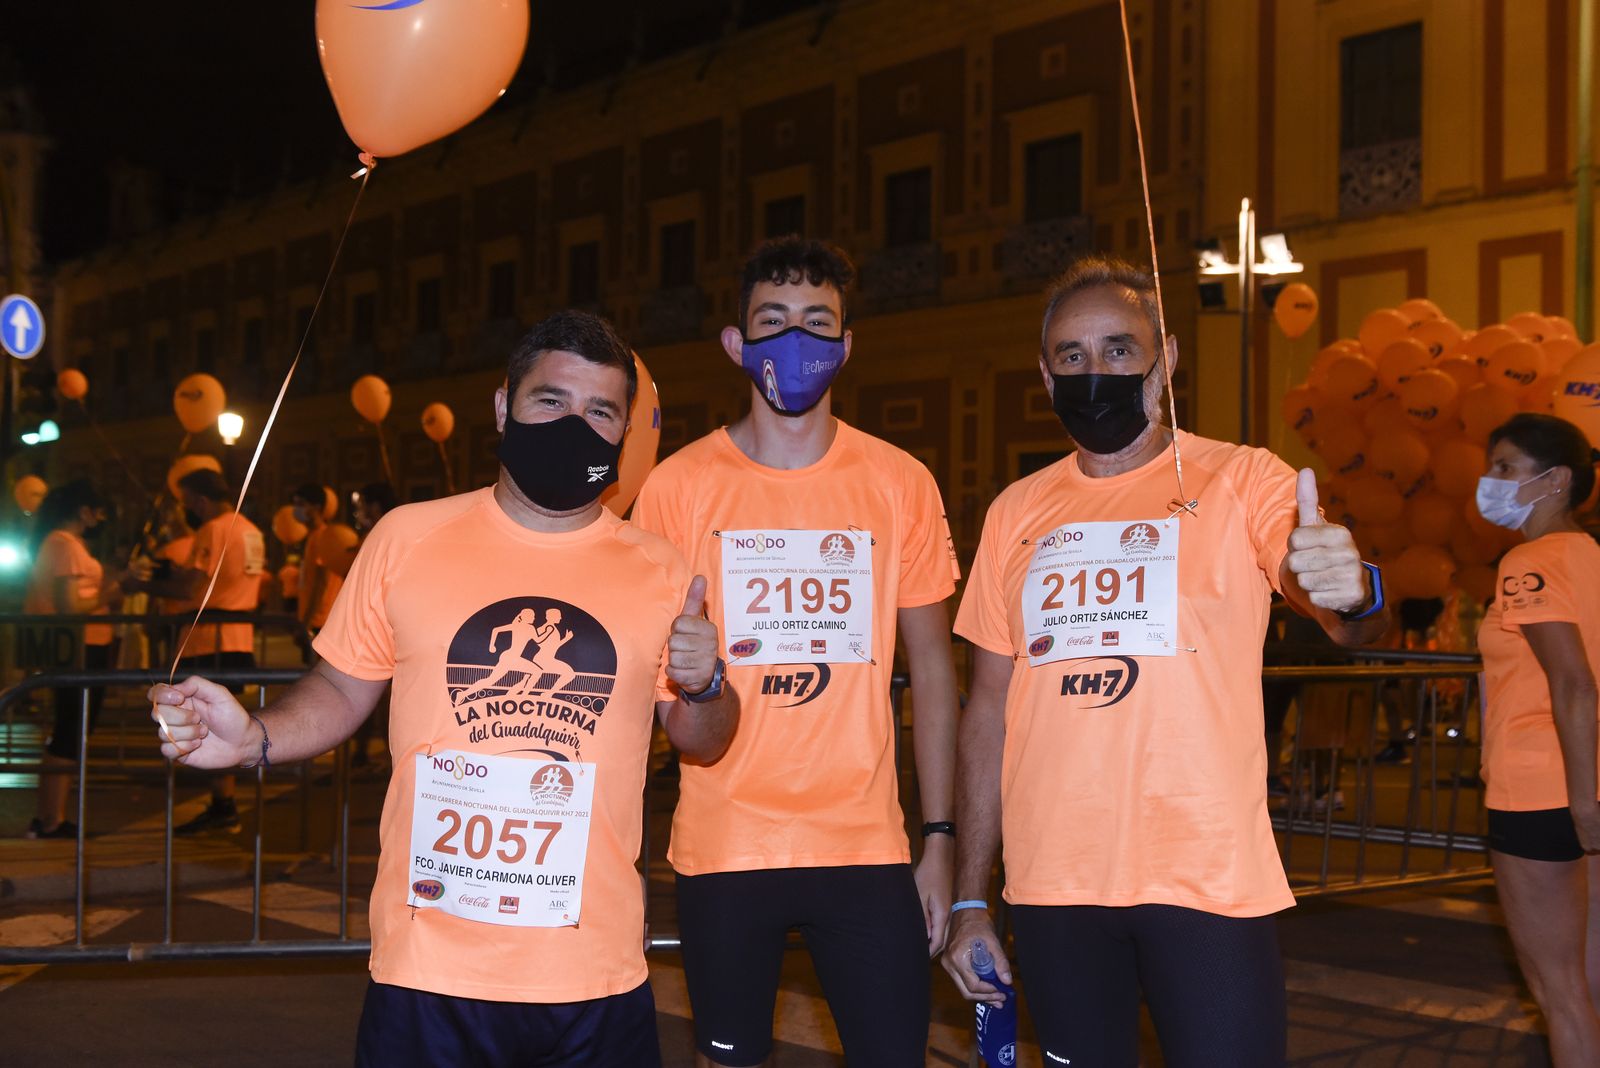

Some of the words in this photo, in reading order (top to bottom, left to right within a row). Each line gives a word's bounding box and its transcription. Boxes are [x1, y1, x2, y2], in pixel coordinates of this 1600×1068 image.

[588, 465, 609, 473] Reebok
[1065, 560, 1094, 568] NOCTURNA
[1106, 556, 1148, 564] GUADALQUIVIR
[746, 577, 852, 615] 2195
[1041, 565, 1145, 611] 2191
[752, 620, 780, 630] JULIO
[782, 620, 808, 630] ORTIZ
[812, 620, 846, 630] CAMINO
[1043, 616, 1067, 627] JULIO
[1070, 613, 1098, 624] ORTIZ
[1101, 610, 1148, 622] SÁNCHEZ
[454, 706, 480, 726] LA
[486, 700, 596, 736] NOCTURNA
[469, 724, 490, 743] del
[492, 720, 581, 750] Guadalquivir
[438, 796, 462, 806] CARRERA
[464, 801, 498, 811] NOCTURNA
[512, 807, 560, 816] GUADALQUIVIR
[432, 808, 562, 865] 2057
[415, 856, 436, 870] FCO.
[438, 862, 473, 879] JAVIER
[476, 869, 534, 885] CARMONA
[536, 874, 576, 886] OLIVER
[549, 900, 568, 908] ABC
